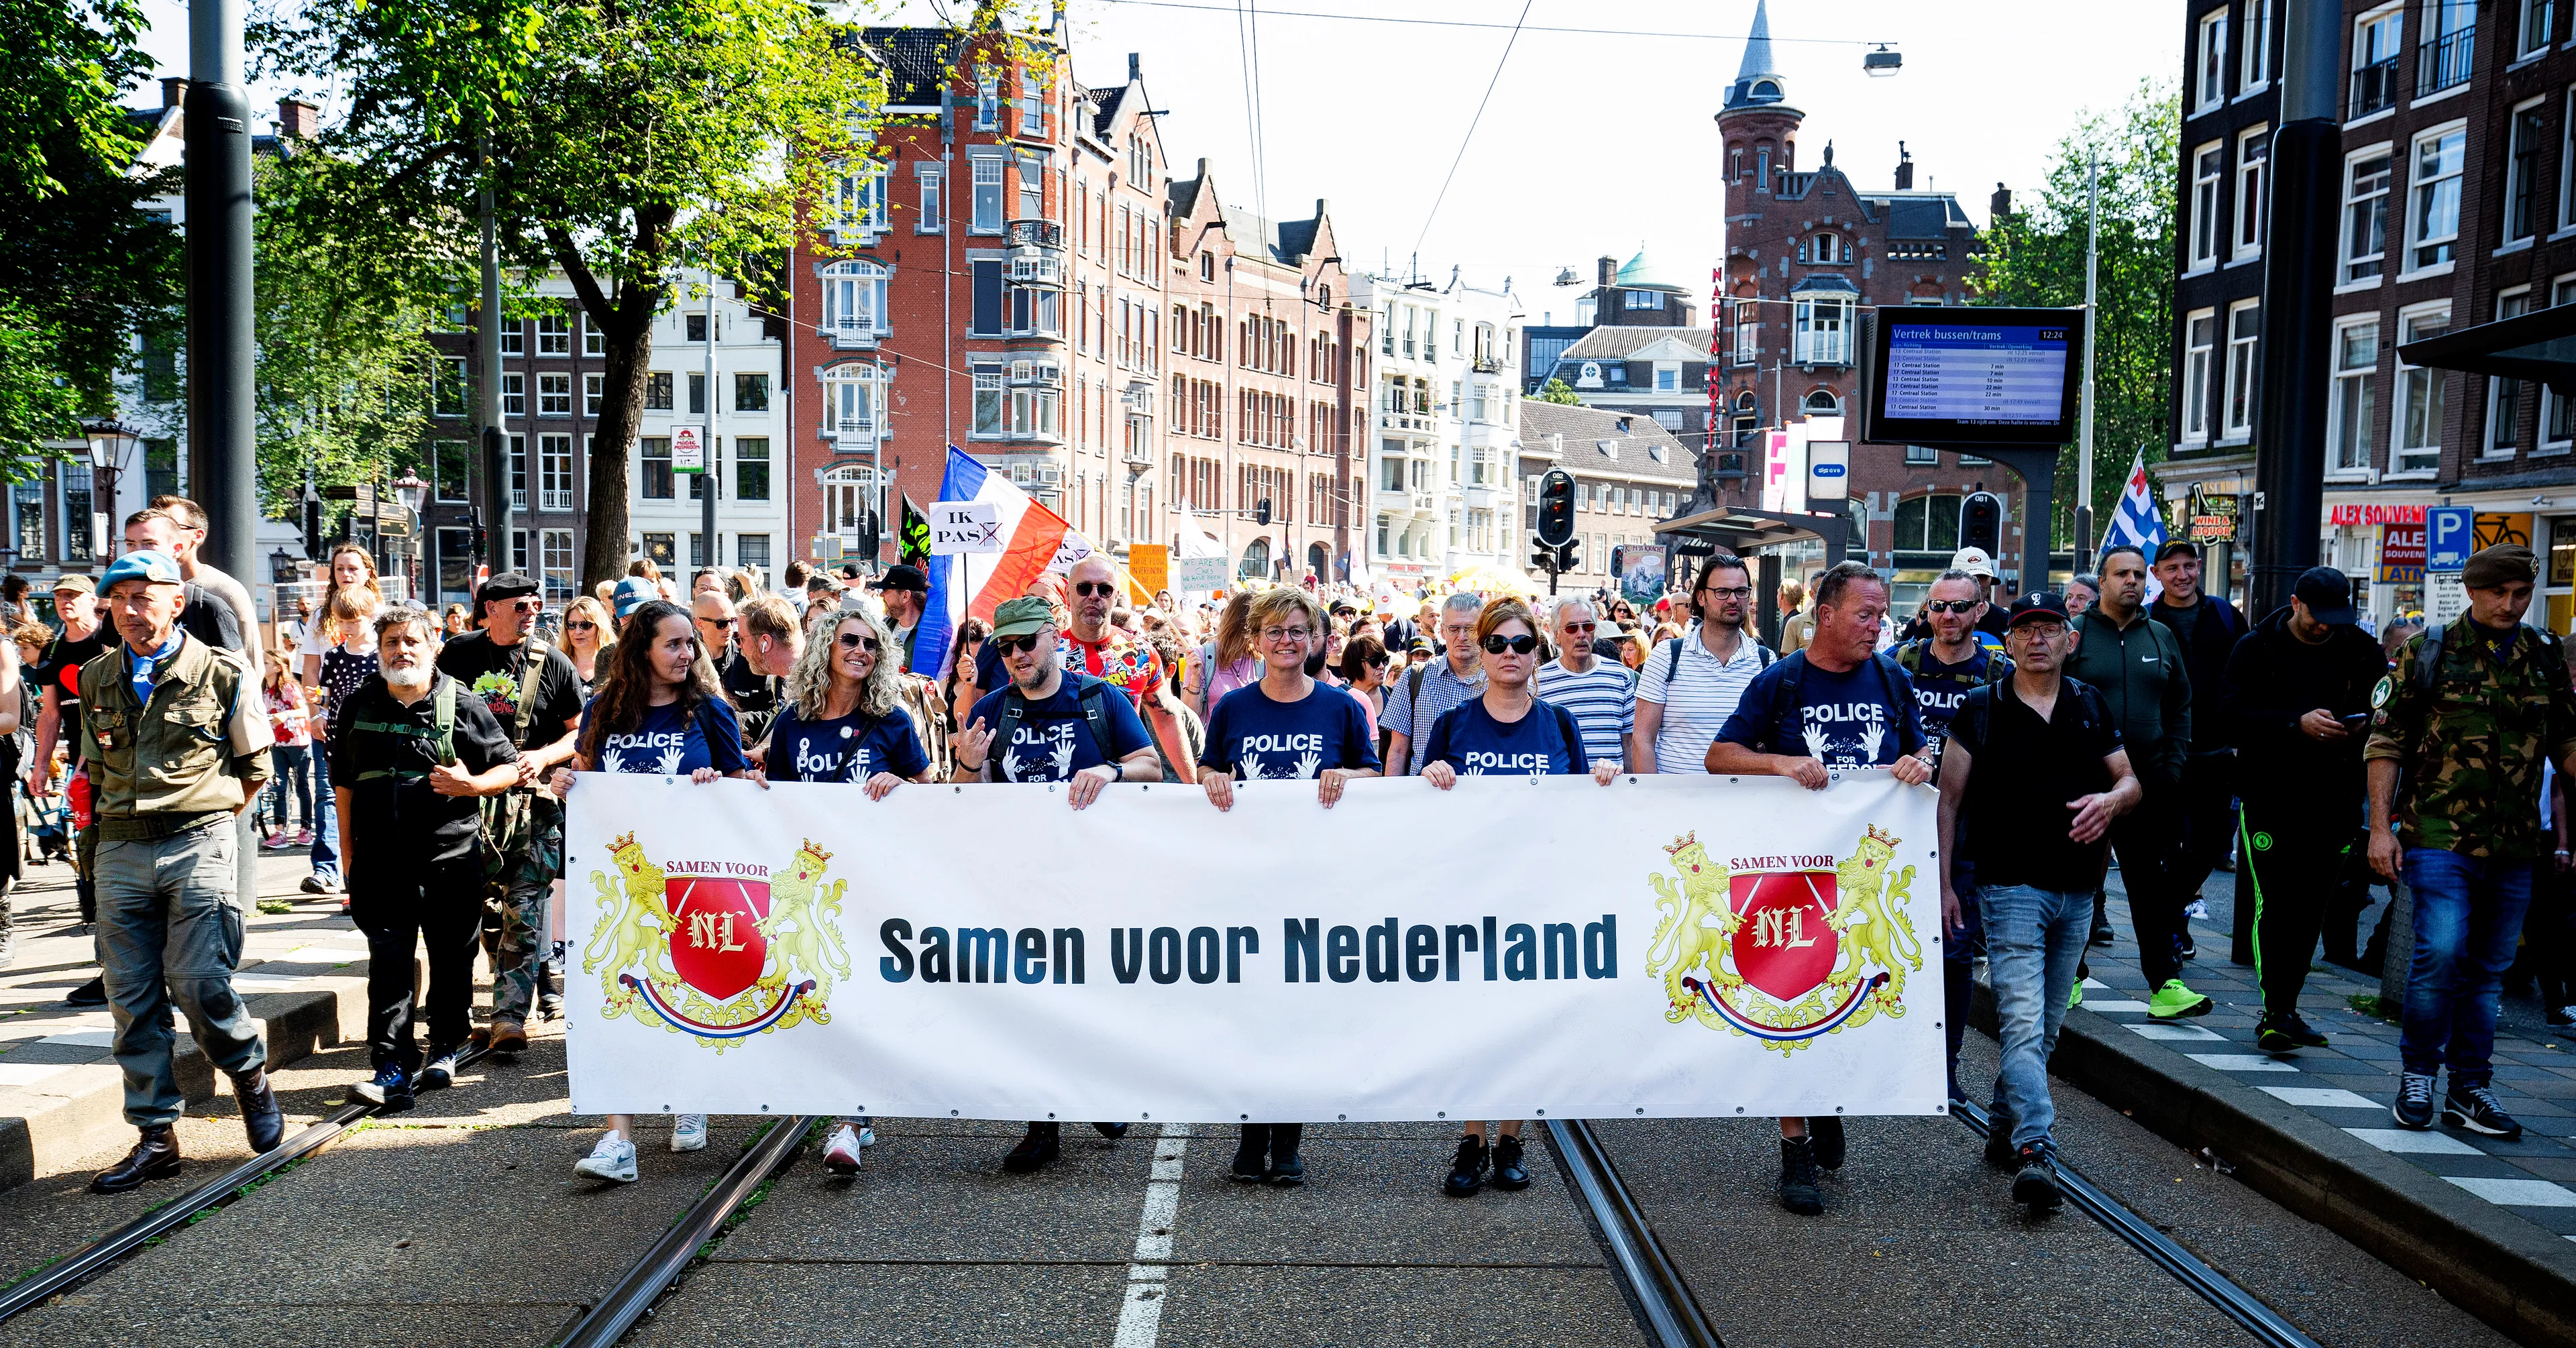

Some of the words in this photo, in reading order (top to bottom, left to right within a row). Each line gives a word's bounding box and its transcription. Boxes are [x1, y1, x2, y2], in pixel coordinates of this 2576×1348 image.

[1711, 267, 1721, 353] NADIA
[1894, 329, 1931, 339] Vertrek
[1935, 329, 2002, 340] bussen/trams
[1708, 366, 1719, 449] HOTEL
[949, 512, 974, 524] IK
[2194, 516, 2220, 525] WINE
[2221, 516, 2231, 525] &
[2330, 505, 2362, 525] ALEX
[2365, 504, 2434, 526] SOUVENI
[937, 530, 981, 543] PAS
[2192, 526, 2232, 536] LIQUOR
[2438, 513, 2462, 545] P
[2386, 531, 2426, 547] ALE
[1132, 546, 1141, 555] WIJ
[1644, 545, 1664, 553] KRACHT
[2385, 550, 2426, 558] SOUVENI
[1053, 555, 1075, 564] AS
[1141, 557, 1147, 565] DE
[1199, 558, 1214, 566] ARE
[1216, 557, 1227, 566] THE
[1913, 688, 1968, 710] POLIC
[1801, 704, 1884, 724] POLICE
[605, 732, 684, 749] POLICE
[1012, 722, 1075, 744] OLICE
[1242, 734, 1323, 753] POLICE
[1466, 752, 1550, 769] POLICE
[1028, 774, 1047, 783] FOR
[666, 860, 722, 873] SAMEN
[724, 862, 769, 877] VOOR
[1731, 856, 1787, 870] SAMEN
[1790, 855, 1834, 868] VOOR
[687, 909, 747, 954] NL
[1752, 905, 1818, 952] NL
[879, 917, 1085, 984] Samen
[1110, 925, 1260, 984] voor
[1283, 914, 1618, 984] Nederland
